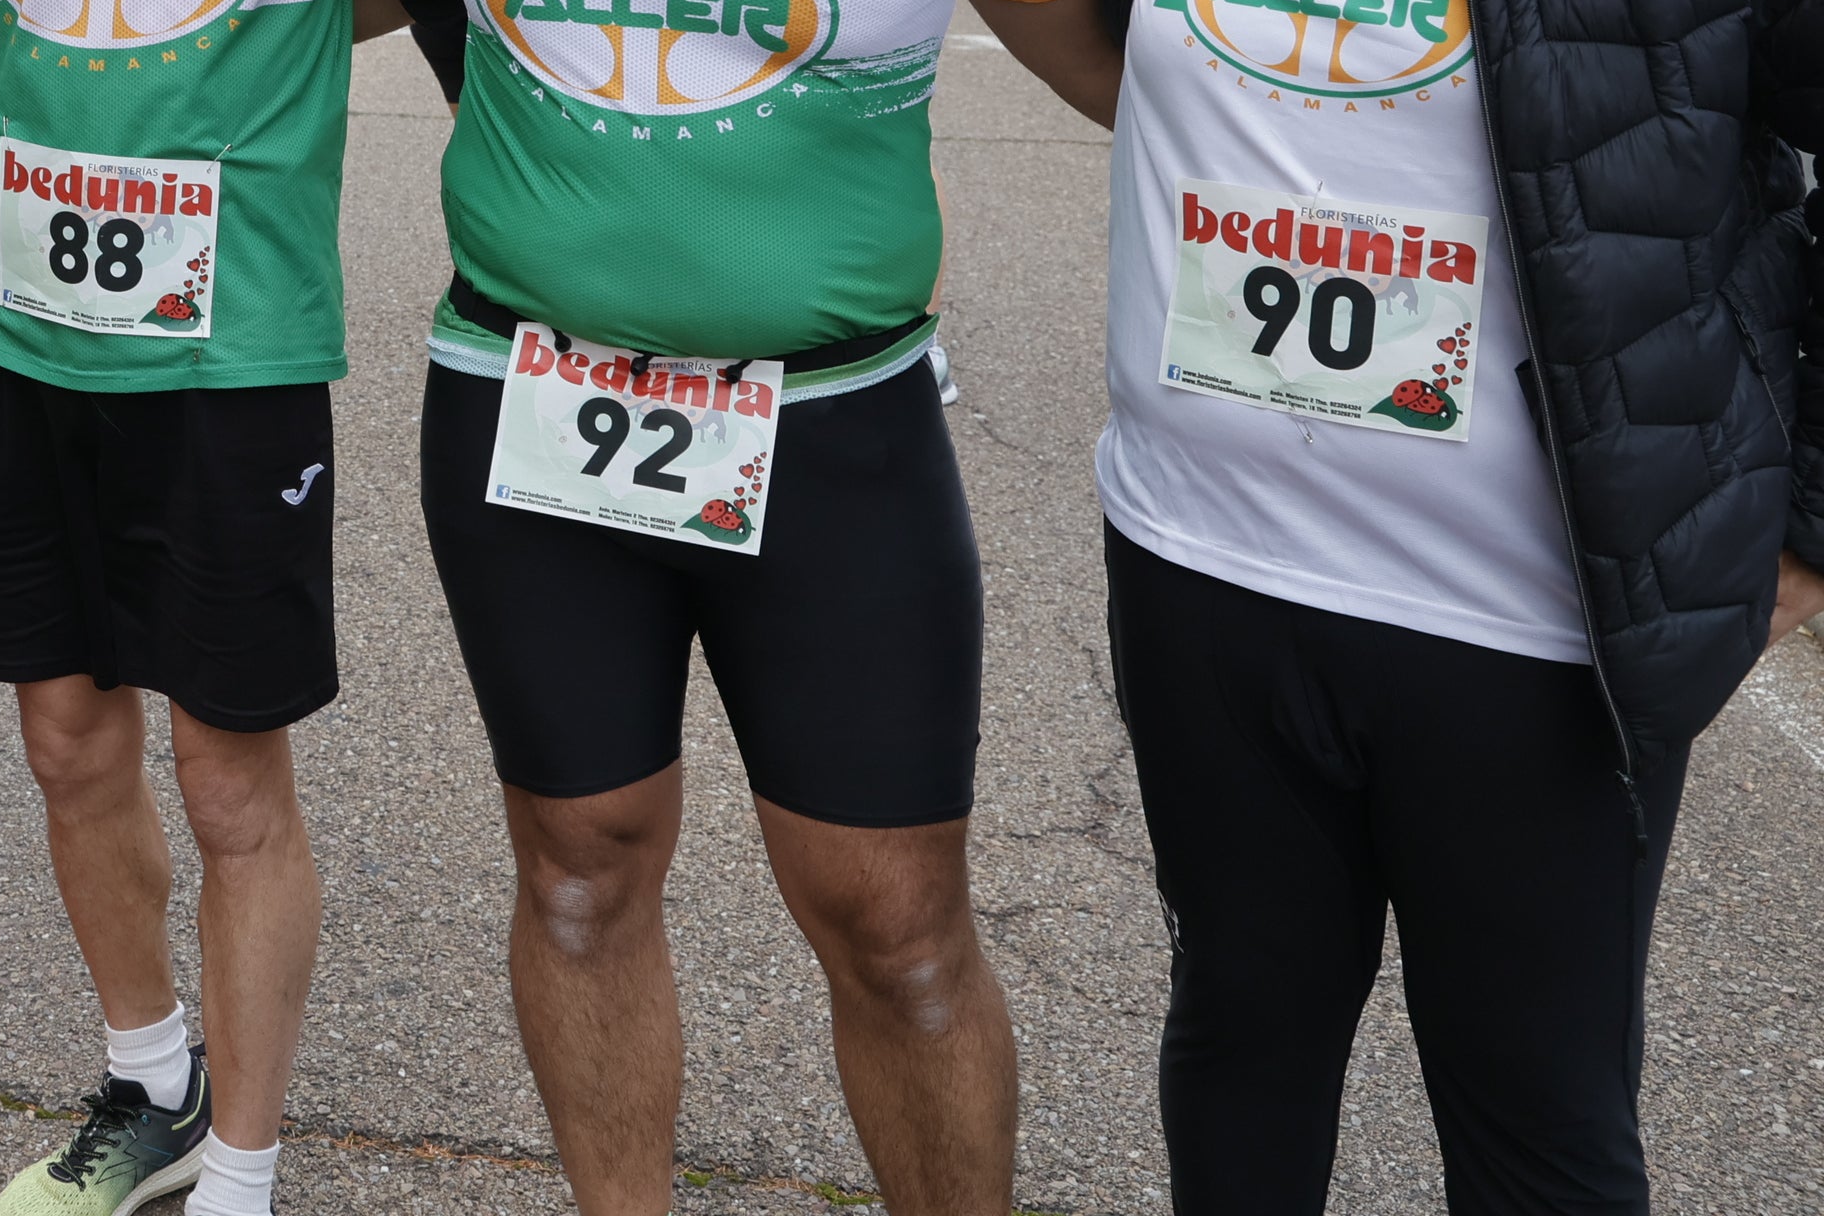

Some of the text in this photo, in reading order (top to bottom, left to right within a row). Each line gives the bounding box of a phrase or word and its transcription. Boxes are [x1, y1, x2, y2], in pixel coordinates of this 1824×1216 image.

[1183, 35, 1466, 113] SALAMANCA
[3, 150, 213, 217] bedunia
[88, 163, 159, 177] FLORISTERÍAS
[49, 211, 145, 292] 88
[1182, 192, 1477, 285] bedunia
[1301, 206, 1397, 229] FLORISTERÍAS
[1243, 265, 1376, 371] 90
[515, 331, 774, 419] bedunia
[648, 360, 712, 372] ORISTERÍAS
[577, 397, 693, 494] 92
